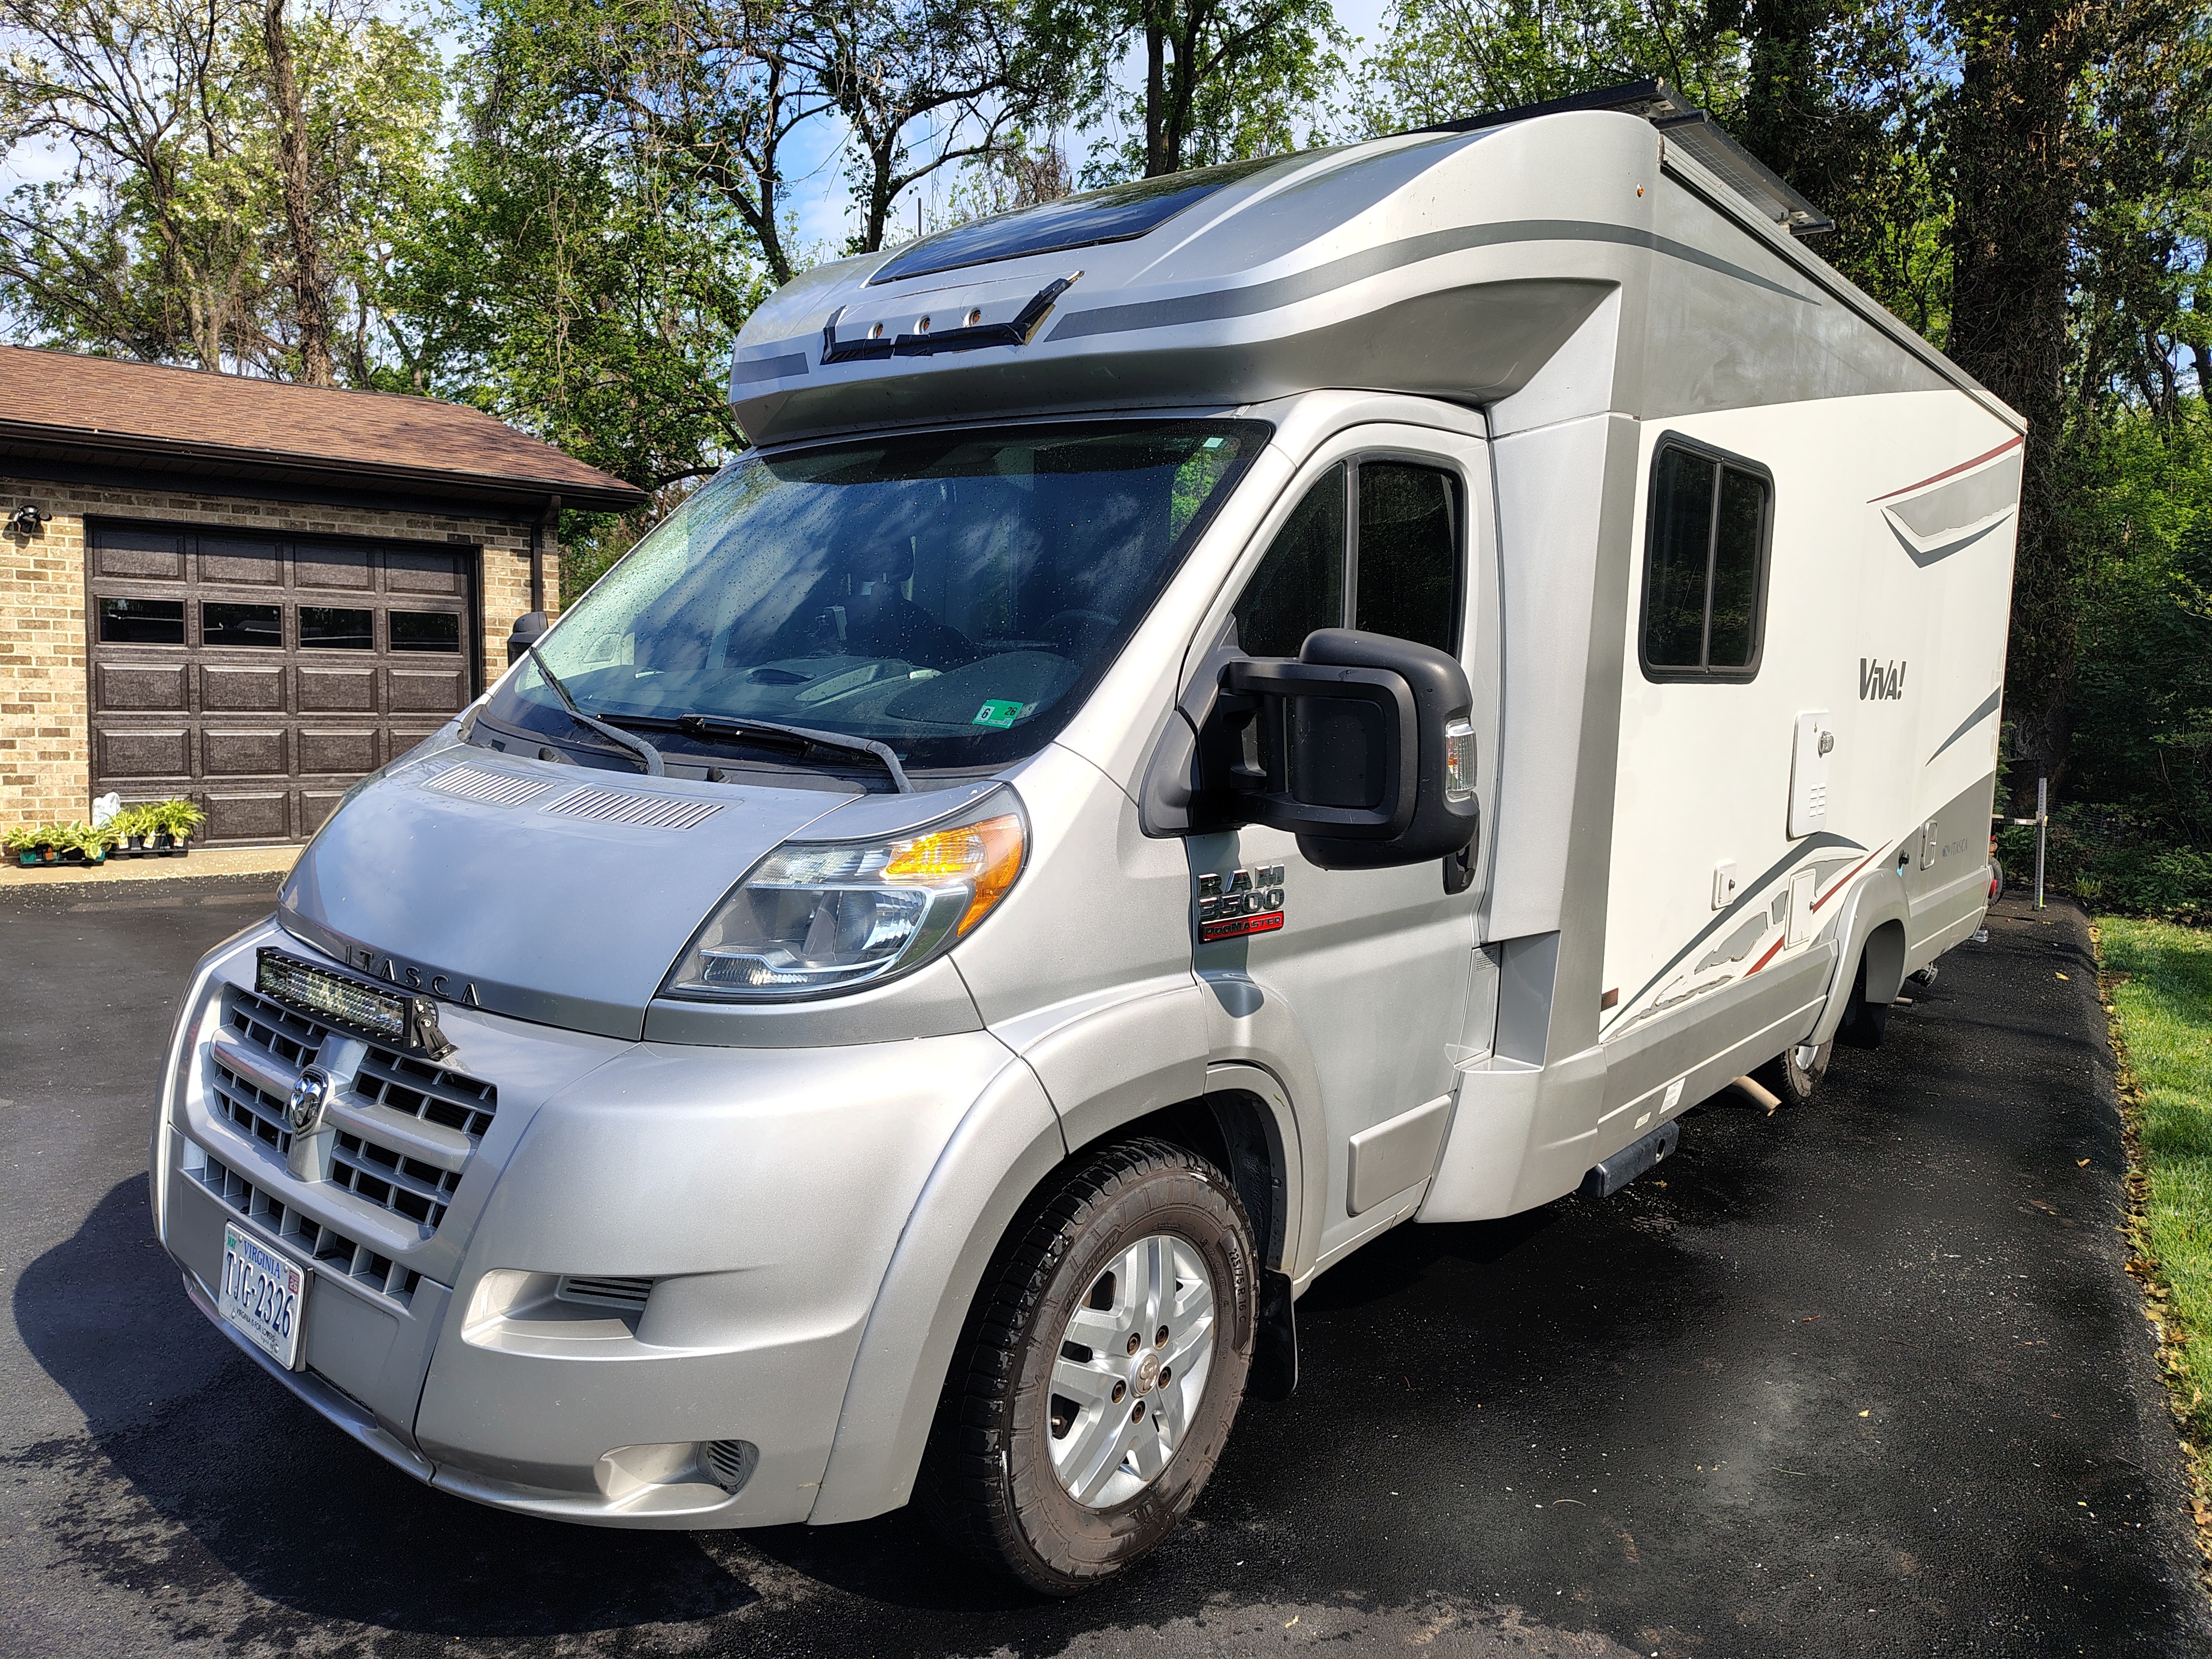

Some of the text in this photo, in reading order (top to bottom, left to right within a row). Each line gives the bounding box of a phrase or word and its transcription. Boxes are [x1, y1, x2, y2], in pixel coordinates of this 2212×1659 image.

[981, 708, 991, 719] 6
[1196, 863, 1285, 898] RAM
[1197, 887, 1285, 922] 3500
[345, 945, 482, 1006] ITASCA
[244, 1240, 281, 1280] VIRGINIA
[1228, 1248, 1245, 1285] 225/75
[225, 1250, 295, 1340] TJG-2326
[289, 1278, 298, 1292] 26
[1237, 1286, 1246, 1296] R
[1238, 1299, 1246, 1311] 16
